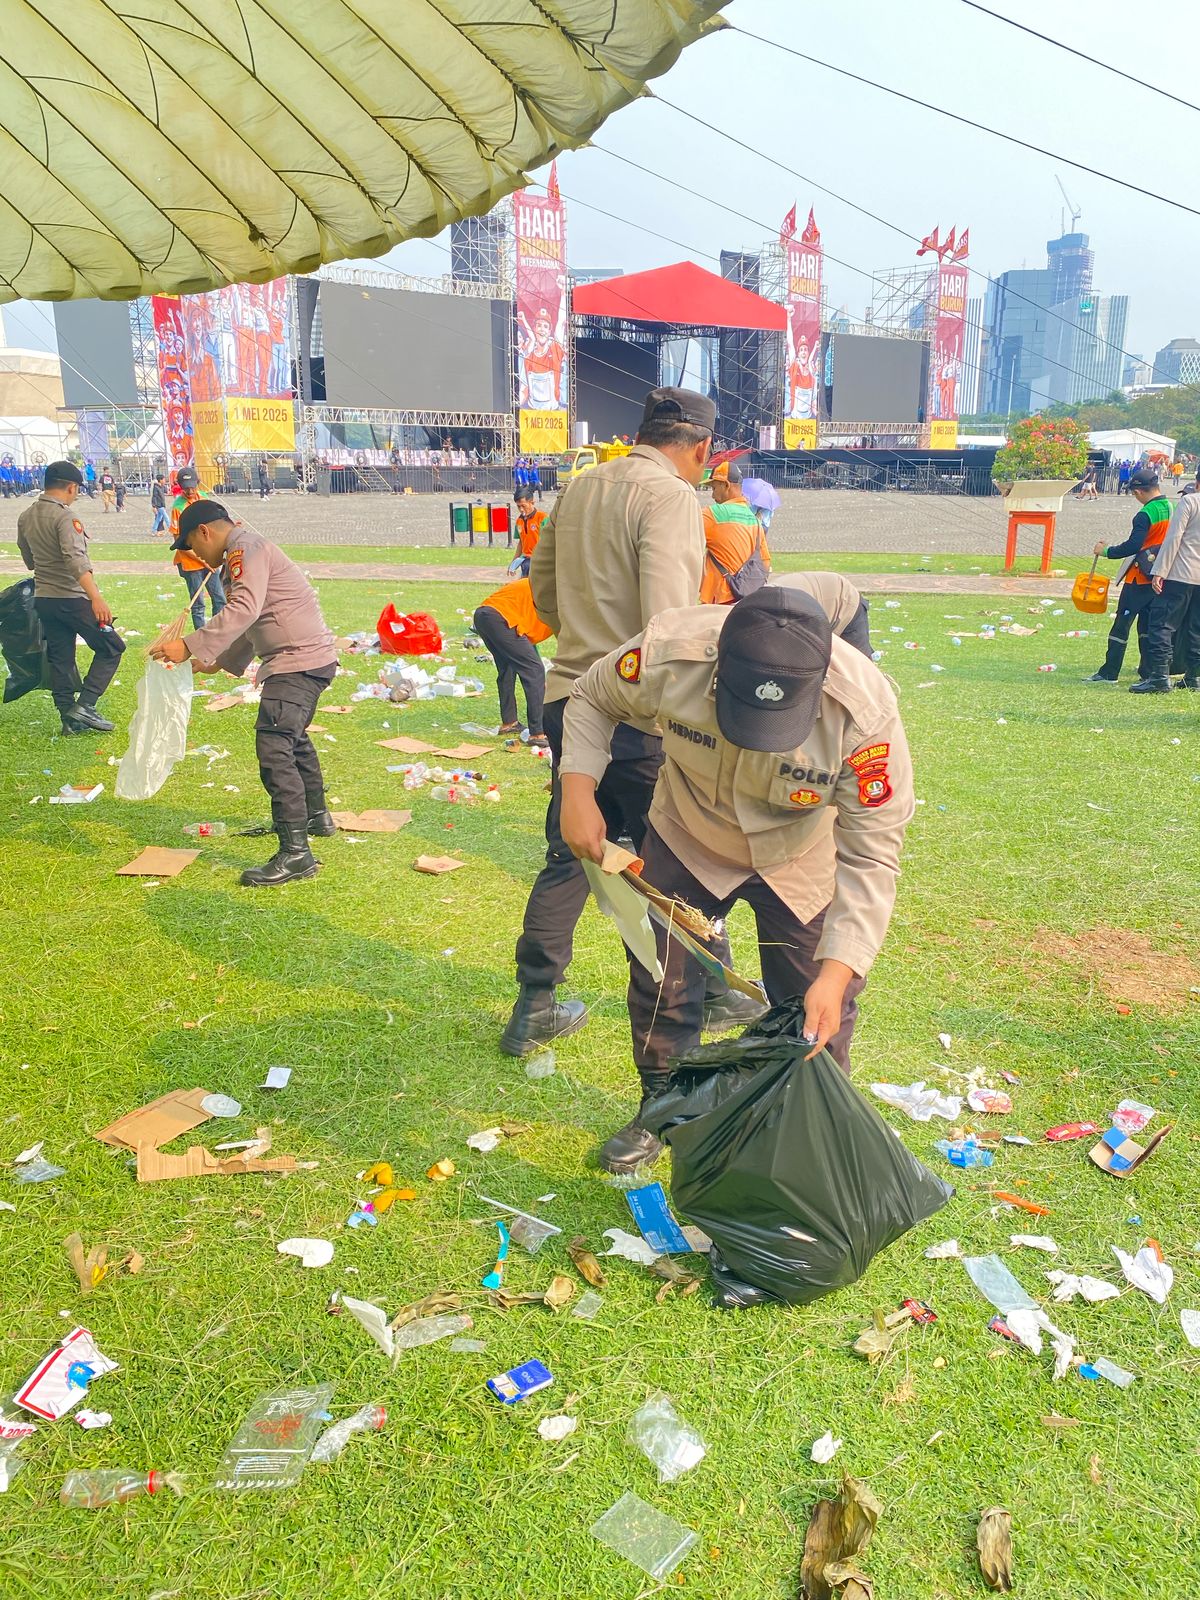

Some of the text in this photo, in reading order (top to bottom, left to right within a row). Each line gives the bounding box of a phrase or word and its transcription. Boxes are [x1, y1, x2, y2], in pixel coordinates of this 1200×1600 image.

[519, 205, 560, 241] HARI
[520, 237, 560, 258] BURUH
[790, 251, 819, 280] HARI
[790, 276, 819, 296] BURUH
[941, 273, 965, 297] HARI
[941, 295, 964, 313] BURUH
[204, 410, 219, 424] 2025
[233, 407, 288, 422] 1 MEI 2025
[524, 416, 563, 430] 1 MEI 2025
[800, 425, 814, 436] 2025
[944, 426, 956, 435] 2025
[668, 719, 717, 750] HENDRI
[779, 762, 836, 786] POLRI
